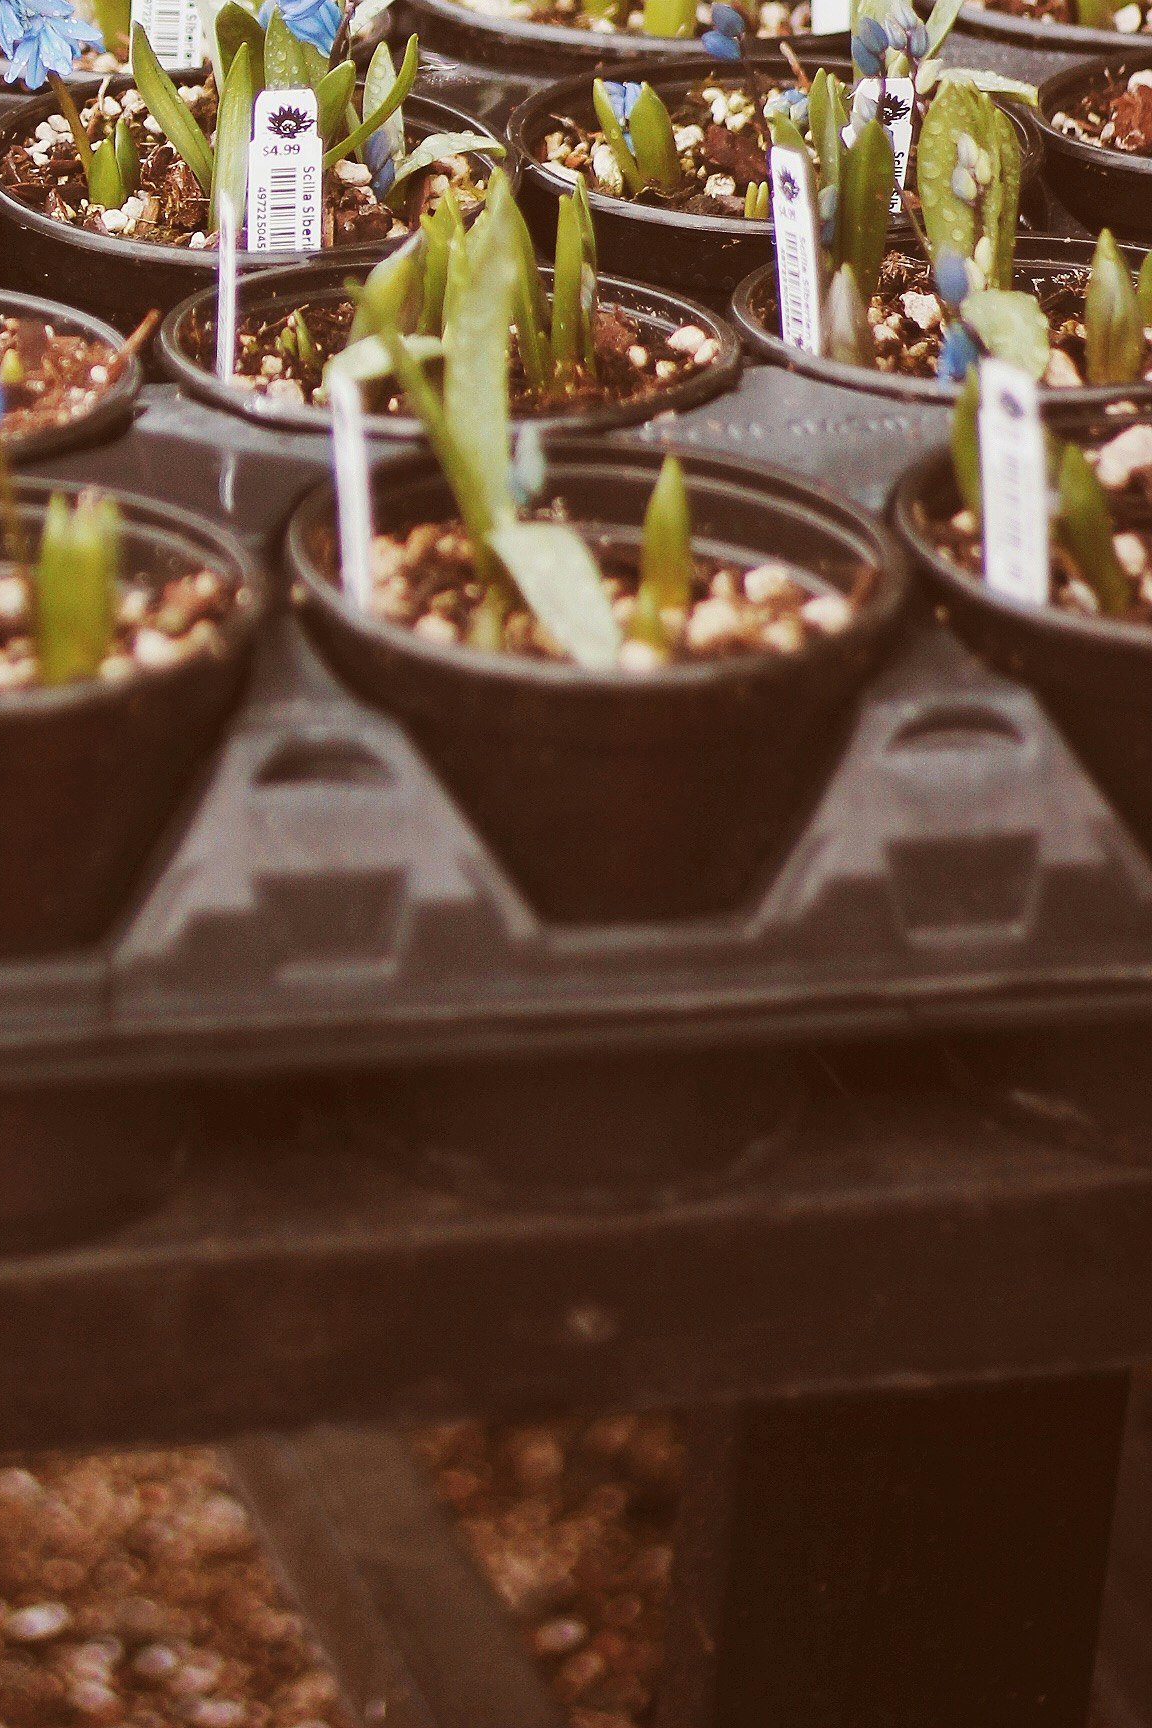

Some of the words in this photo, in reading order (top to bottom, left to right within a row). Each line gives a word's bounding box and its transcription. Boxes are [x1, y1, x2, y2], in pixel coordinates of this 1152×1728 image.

[263, 144, 301, 157] $4.99
[302, 166, 315, 201] Scilla
[302, 206, 315, 250] Siberi
